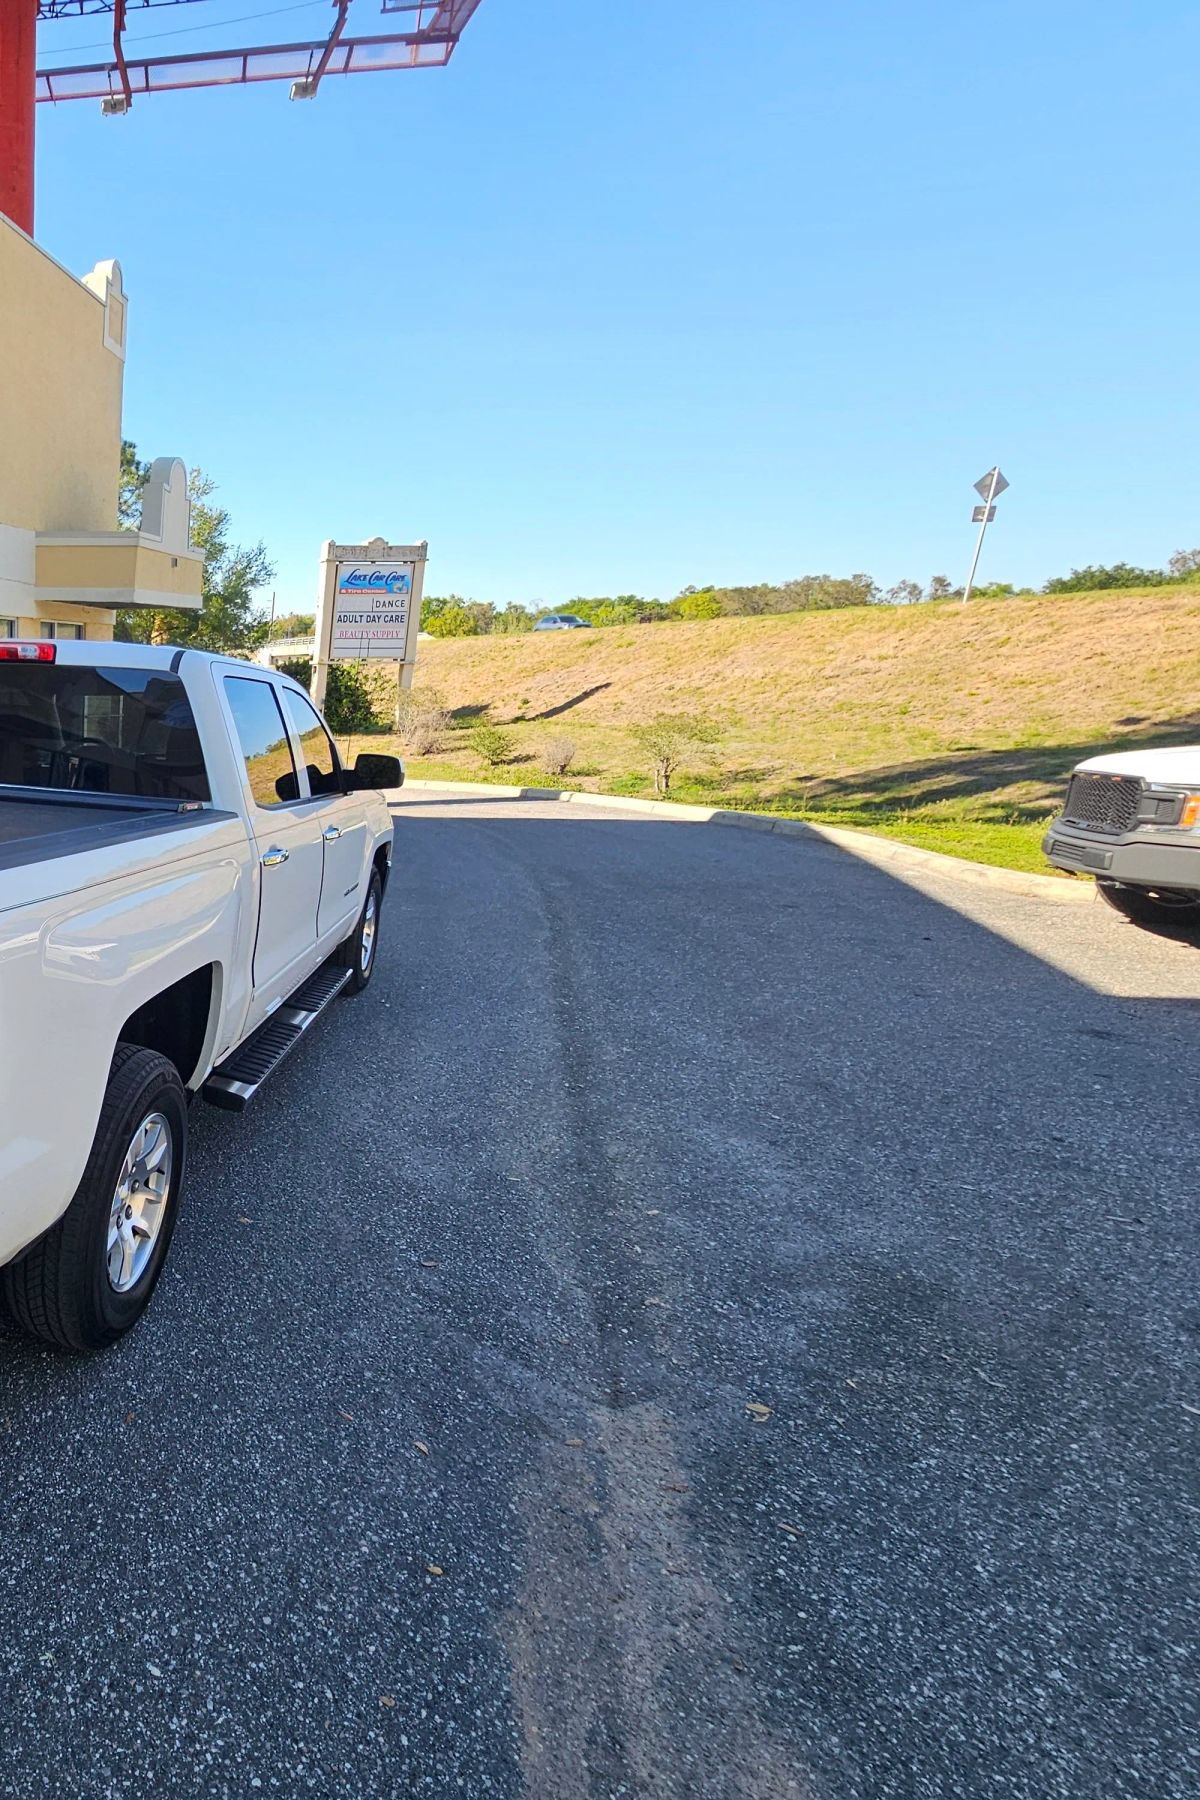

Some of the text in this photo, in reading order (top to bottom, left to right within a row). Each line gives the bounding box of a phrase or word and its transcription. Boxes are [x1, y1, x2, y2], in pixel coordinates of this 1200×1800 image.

[368, 571, 386, 586] CAR
[375, 600, 406, 608] DANCE
[337, 614, 405, 623] ADULT DAY CARE
[339, 630, 401, 638] BEAUTY SUPPLY
